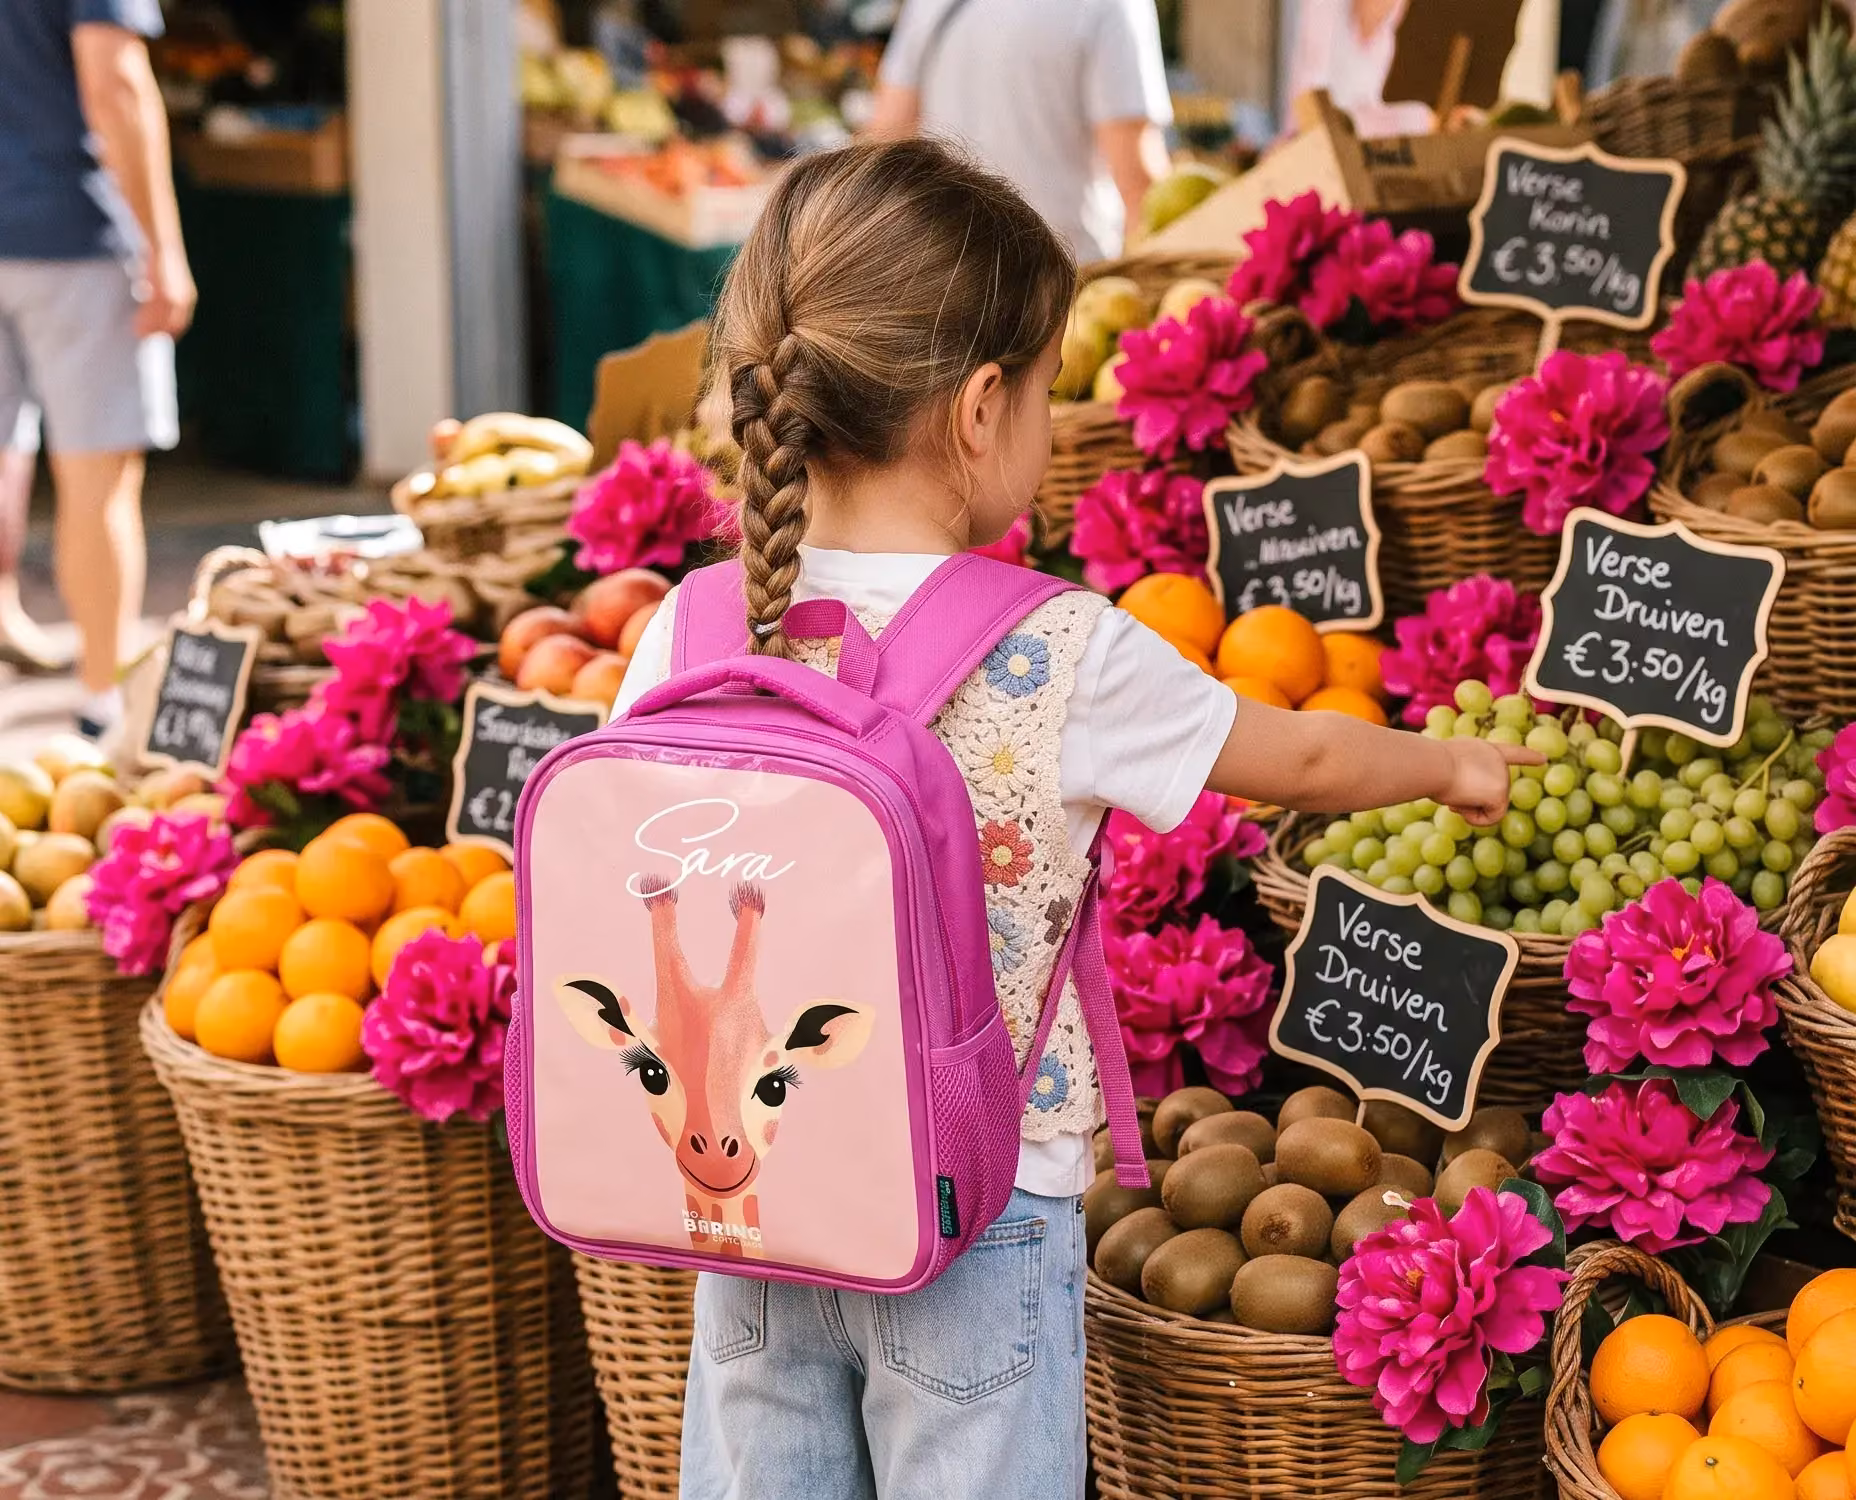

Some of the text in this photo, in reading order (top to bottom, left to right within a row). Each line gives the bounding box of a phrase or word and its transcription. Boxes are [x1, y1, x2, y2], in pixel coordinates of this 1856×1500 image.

[1506, 160, 1583, 202] Verse
[1223, 493, 1298, 536] Verse
[1586, 534, 1673, 589] Verse
[1593, 583, 1729, 647] Druiven
[625, 797, 797, 899] Sara
[1337, 901, 1423, 970] Verse
[1314, 944, 1449, 1032] Druiven
